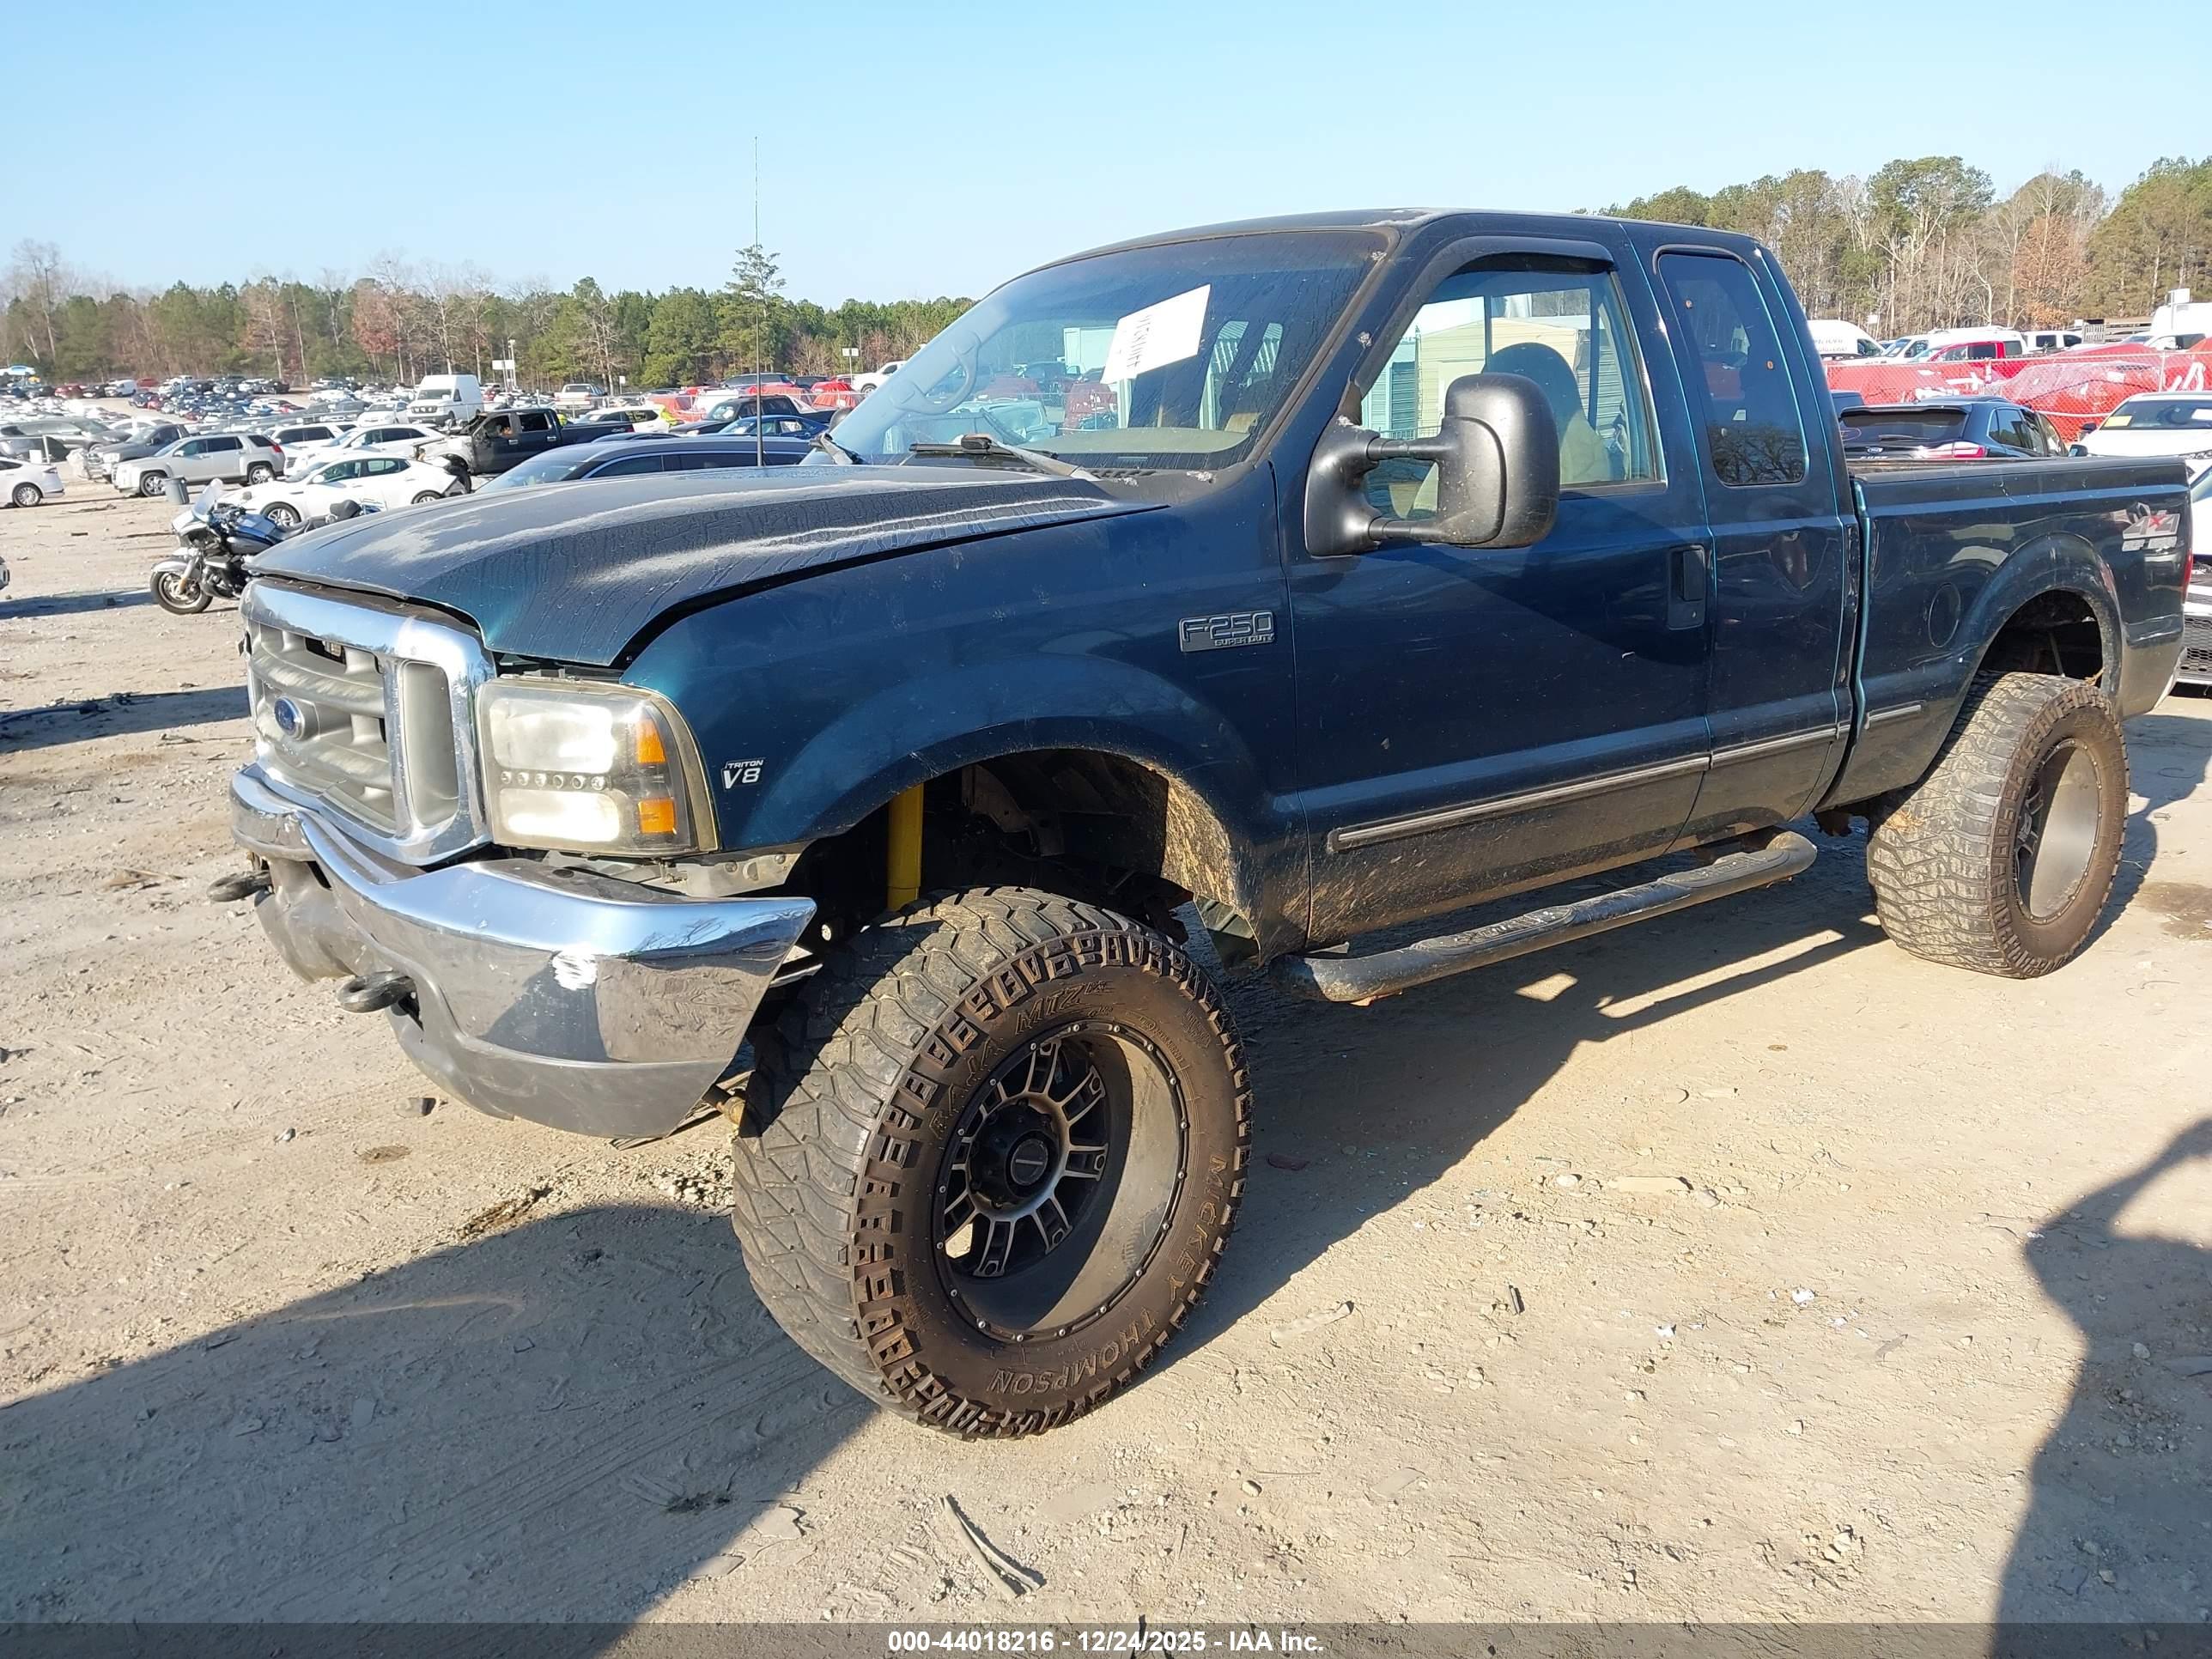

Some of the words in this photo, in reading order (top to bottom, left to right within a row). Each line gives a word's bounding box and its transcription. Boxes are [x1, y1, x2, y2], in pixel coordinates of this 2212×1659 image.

[1214, 635, 1248, 647] SUPER
[1249, 632, 1275, 644] DUTY
[725, 759, 764, 769] TRITON
[723, 768, 761, 789] V8
[1166, 1153, 1229, 1305] MICKEY
[987, 1306, 1159, 1395] THOMPSON
